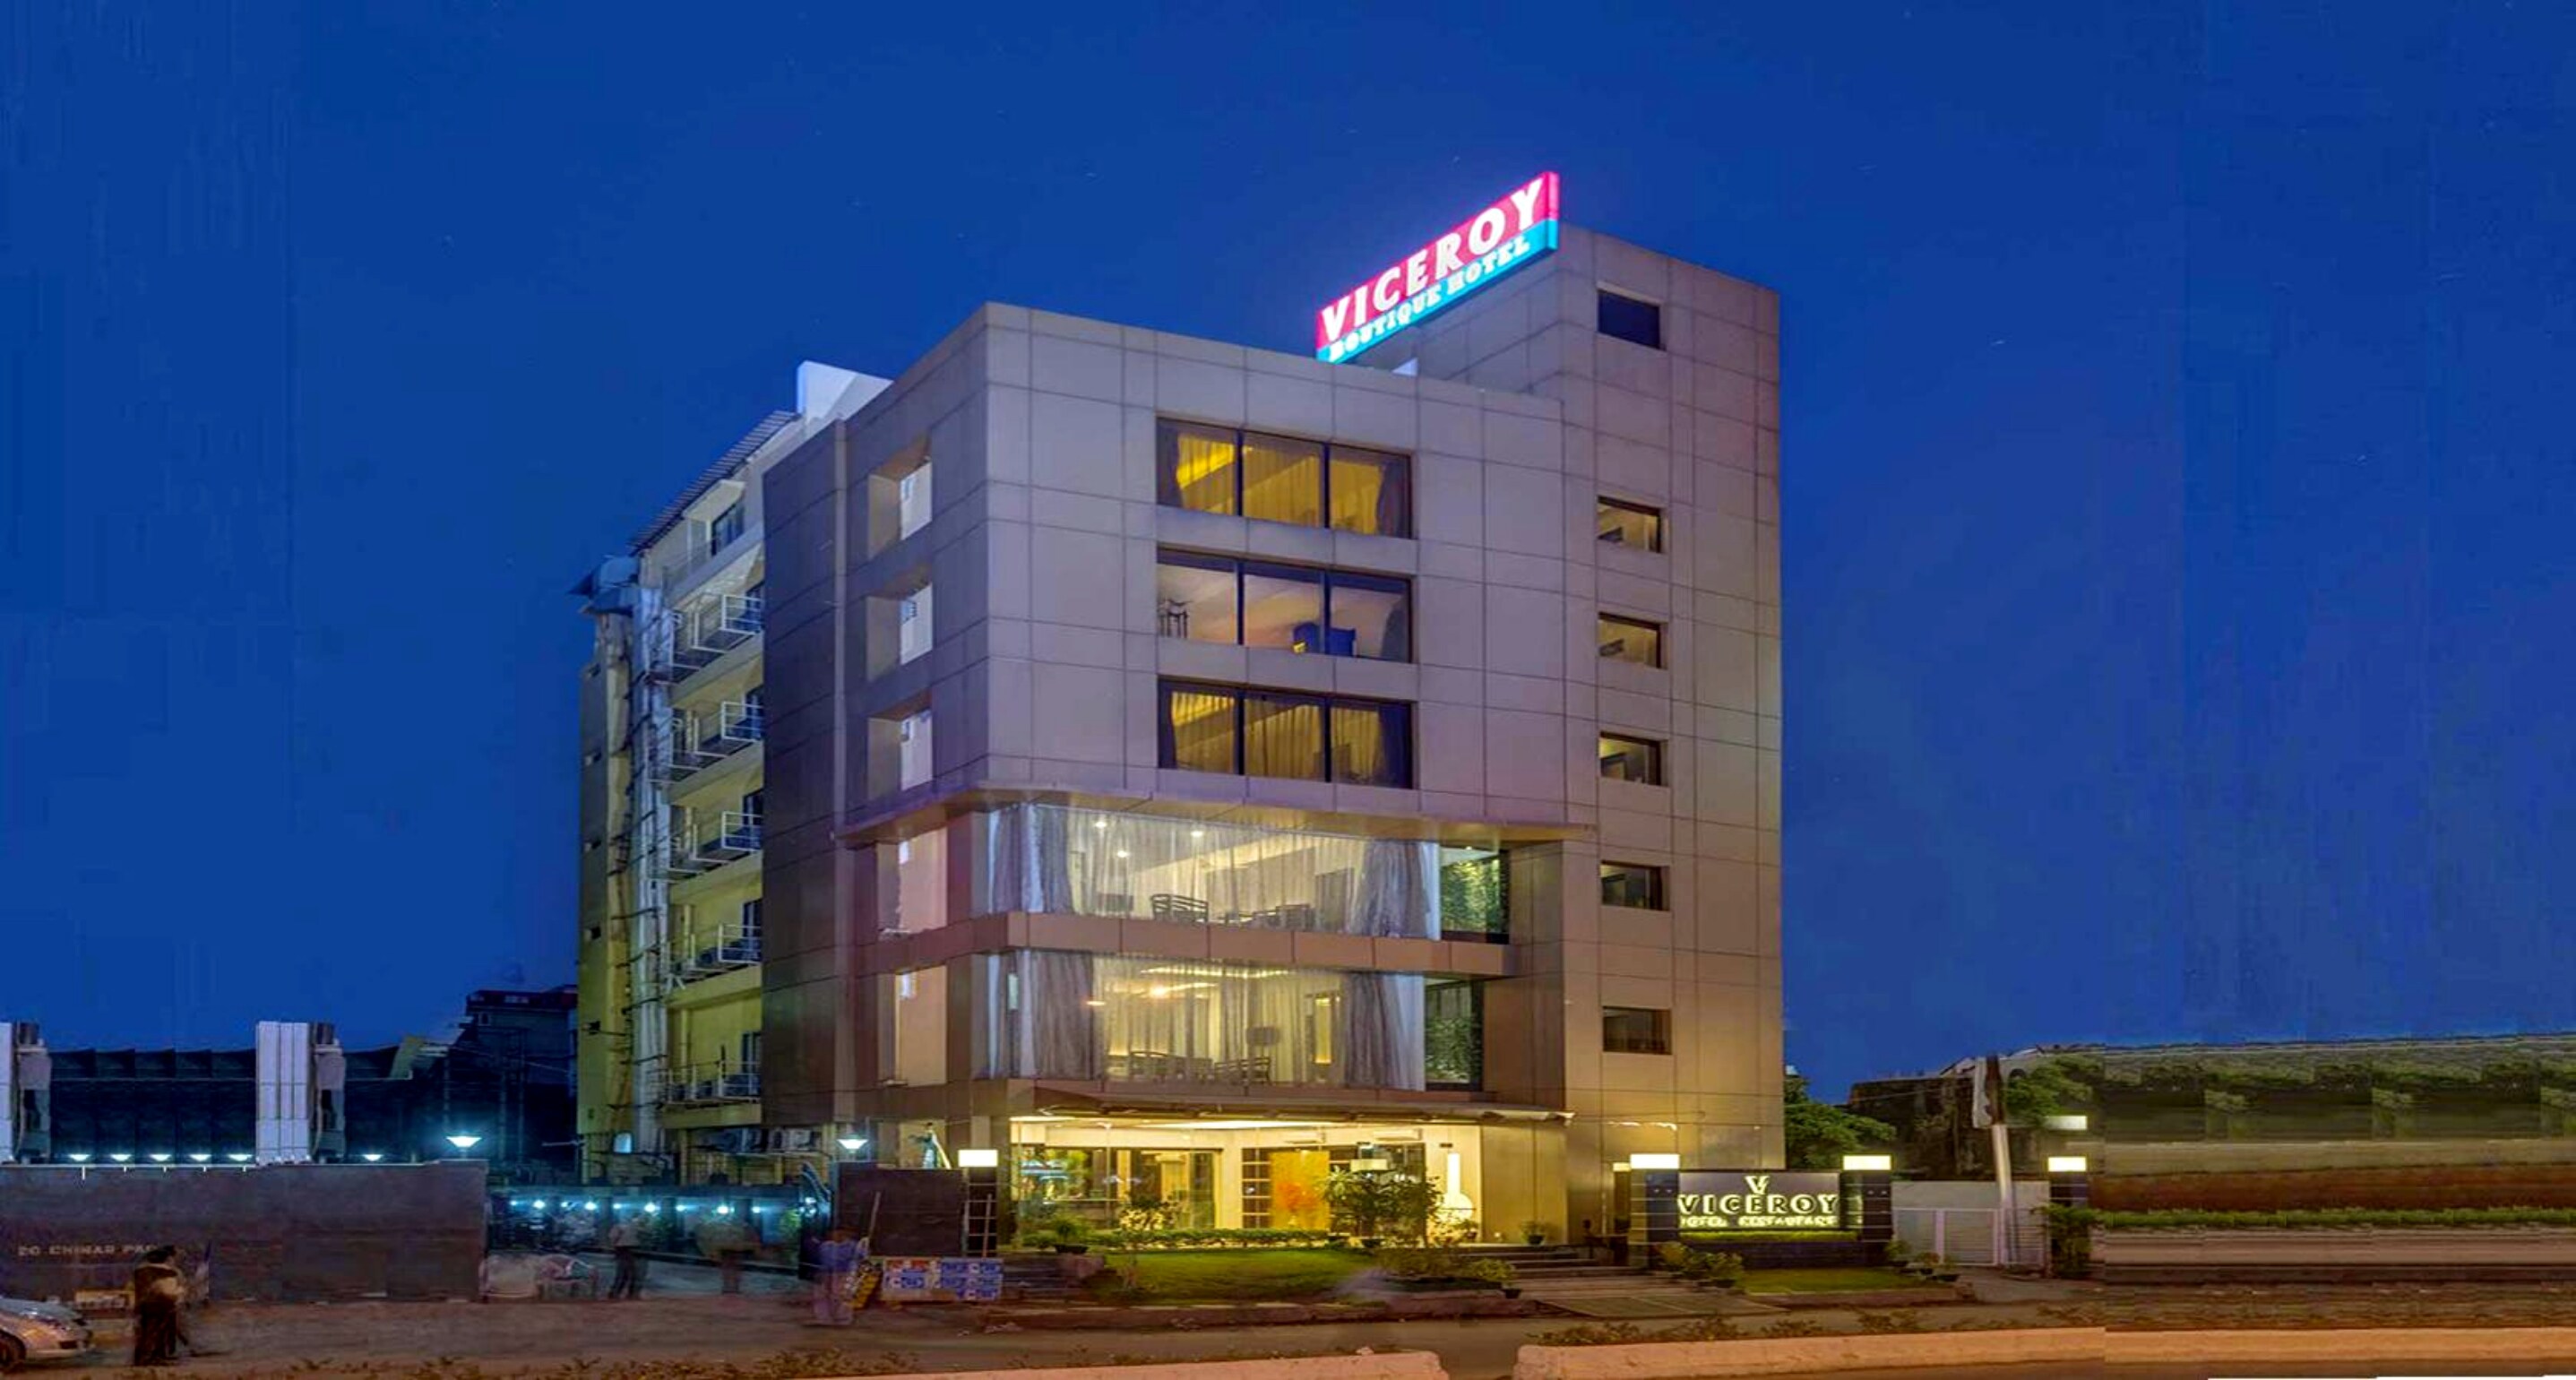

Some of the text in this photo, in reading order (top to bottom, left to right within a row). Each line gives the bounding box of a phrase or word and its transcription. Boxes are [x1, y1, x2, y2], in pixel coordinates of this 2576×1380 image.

[1322, 177, 1544, 342] VICEROY
[1328, 233, 1531, 362] BOUTIQUE HOTEL
[1677, 1194, 1838, 1214] VICEROY
